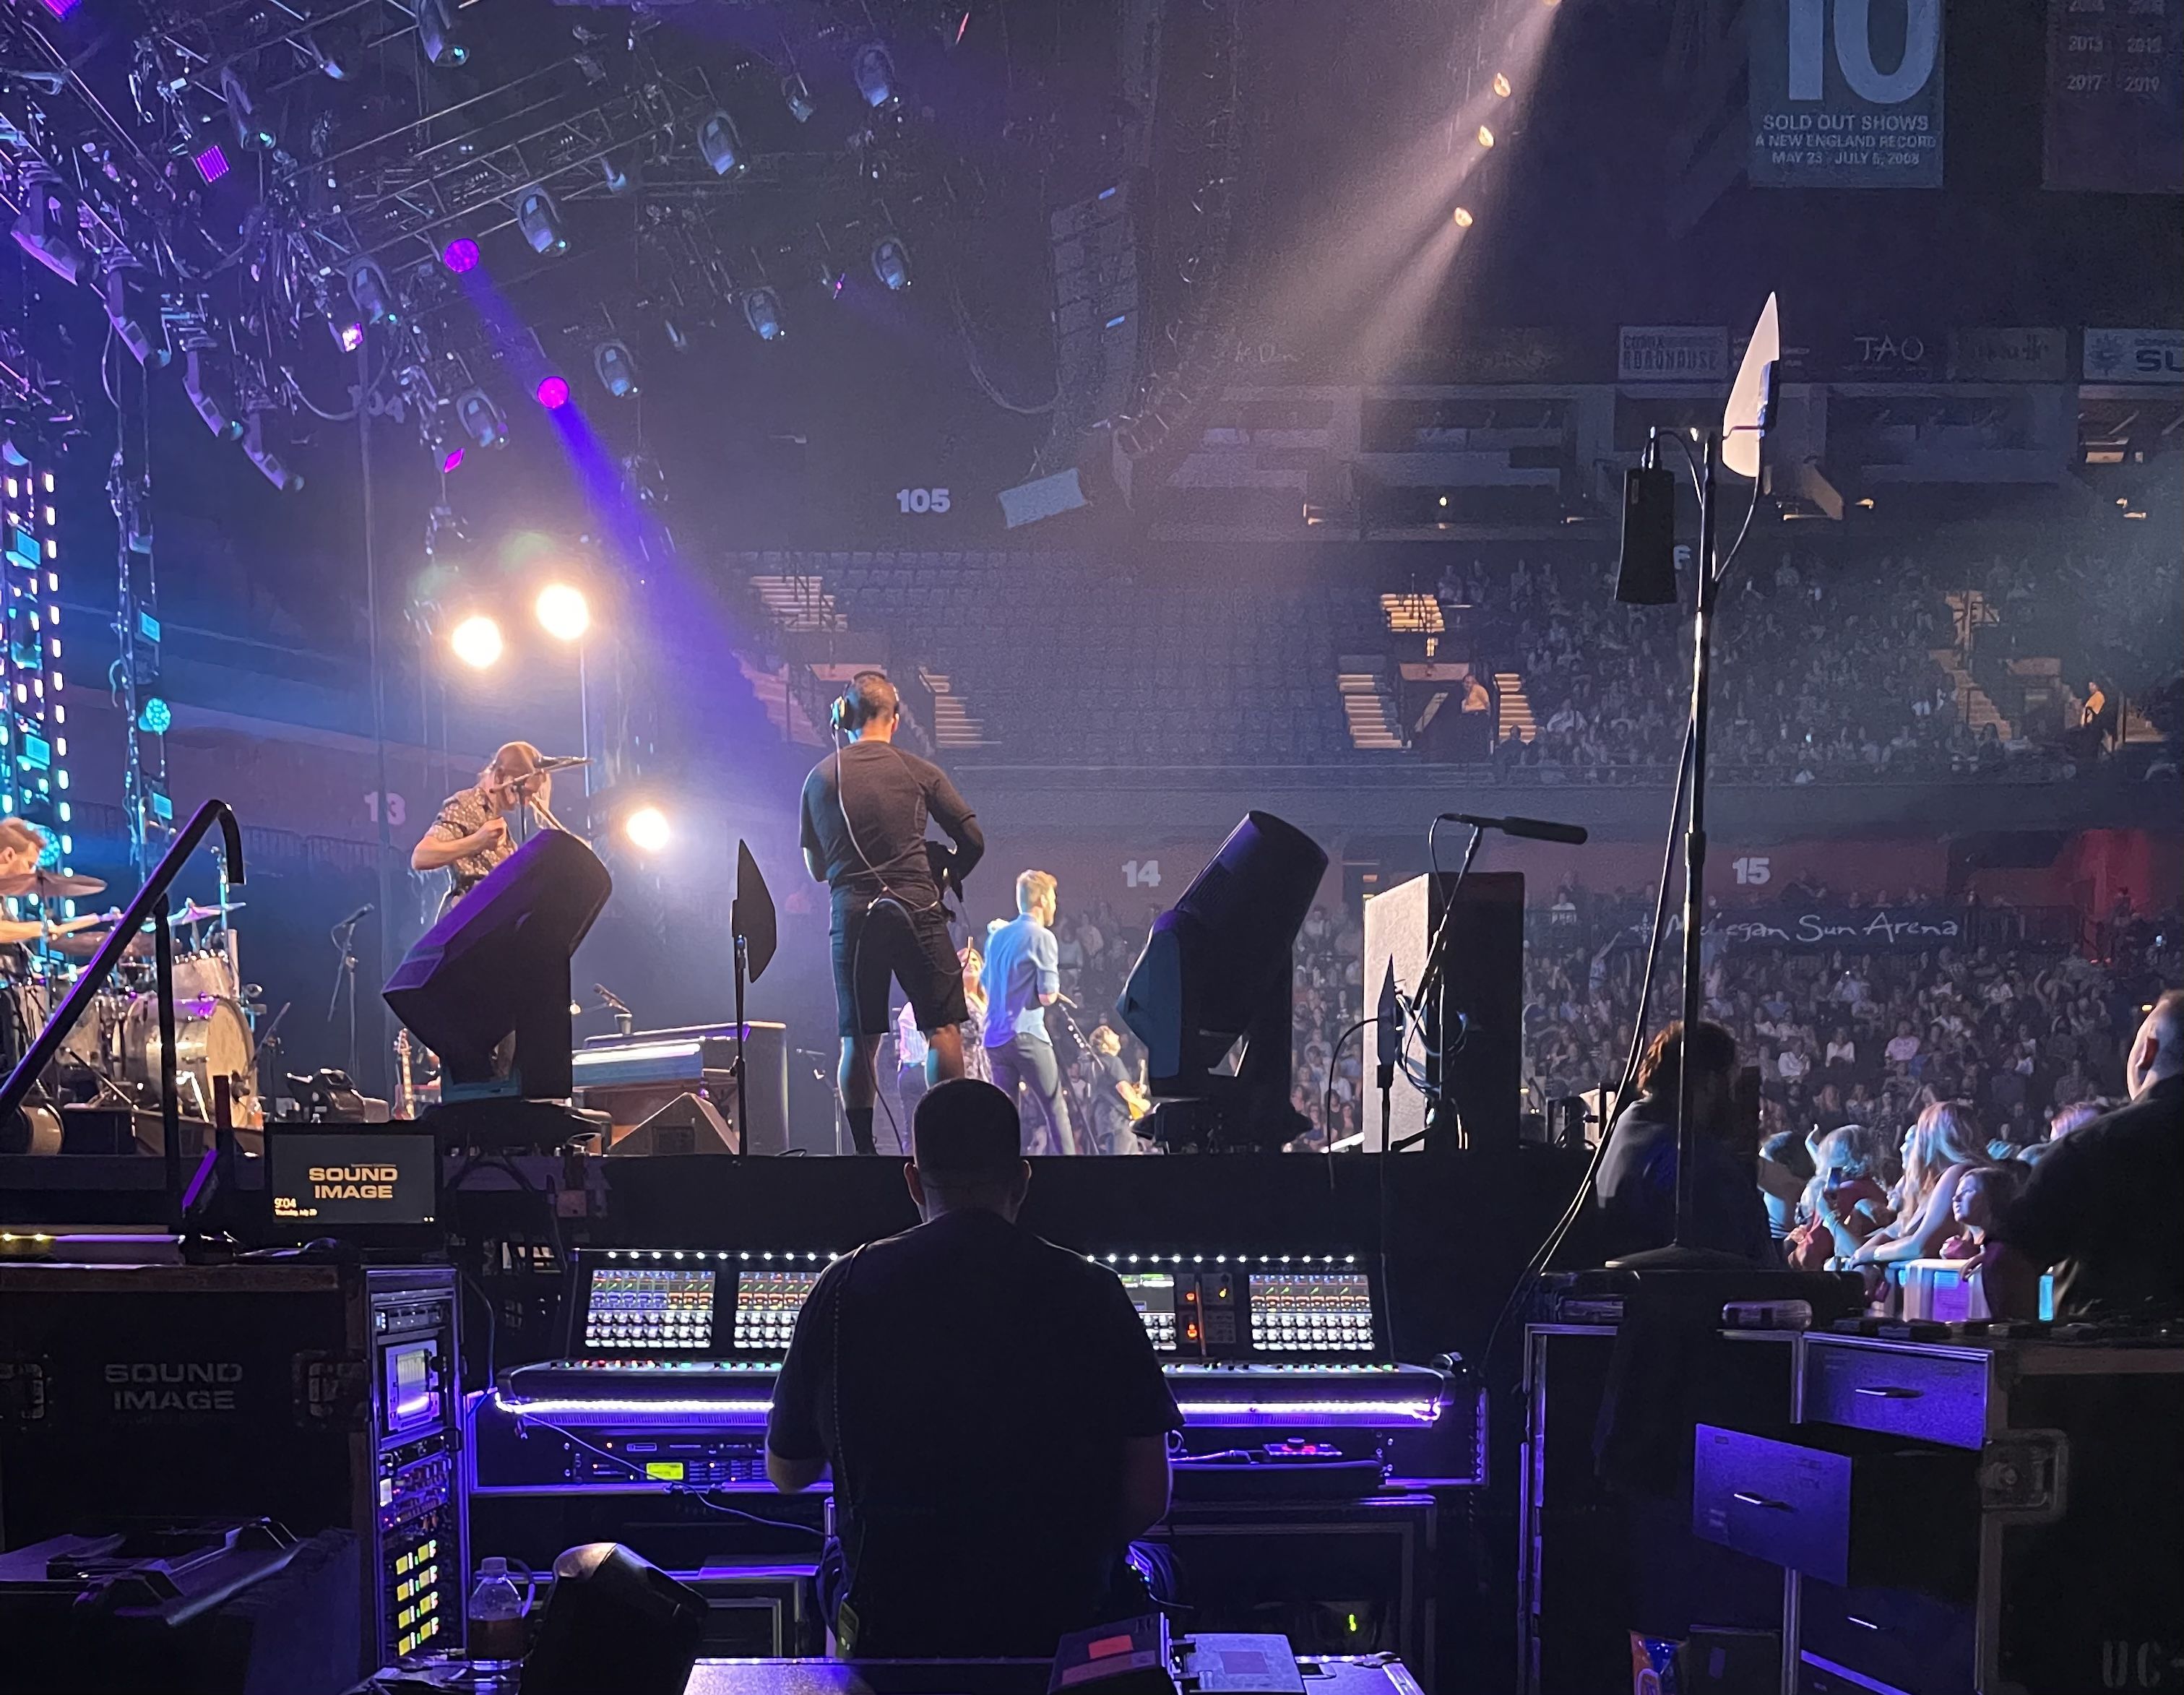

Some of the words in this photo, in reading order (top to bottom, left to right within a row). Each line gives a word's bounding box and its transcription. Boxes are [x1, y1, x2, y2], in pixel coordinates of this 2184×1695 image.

[1789, 0, 1942, 104] 10
[2067, 74, 2104, 92] 2017
[1763, 114, 1812, 131] SOLD
[1817, 114, 1856, 131] OUT
[1860, 114, 1929, 131] SHOWS
[1755, 134, 1764, 147] A
[1769, 134, 1803, 148] NEW
[1806, 134, 1876, 148] ENGLAND
[1879, 135, 1937, 149] RECORD
[1771, 151, 1804, 165] MAY
[1807, 151, 1823, 165] 23
[1834, 151, 1870, 165] JULY
[1887, 152, 1920, 165] 2008
[1853, 335, 1925, 362] TAO
[1623, 349, 1719, 371] ROADHOUSE
[897, 488, 951, 514] 105
[363, 791, 407, 826] 13
[1121, 860, 1161, 888] 14
[1732, 857, 1771, 886] 15
[1796, 914, 1857, 941] Sun
[1863, 911, 1958, 943] Arena
[308, 1167, 398, 1182] SOUND
[314, 1184, 394, 1199] IMAGE
[104, 1362, 243, 1383] SOUND
[113, 1389, 236, 1410] IMAGE
